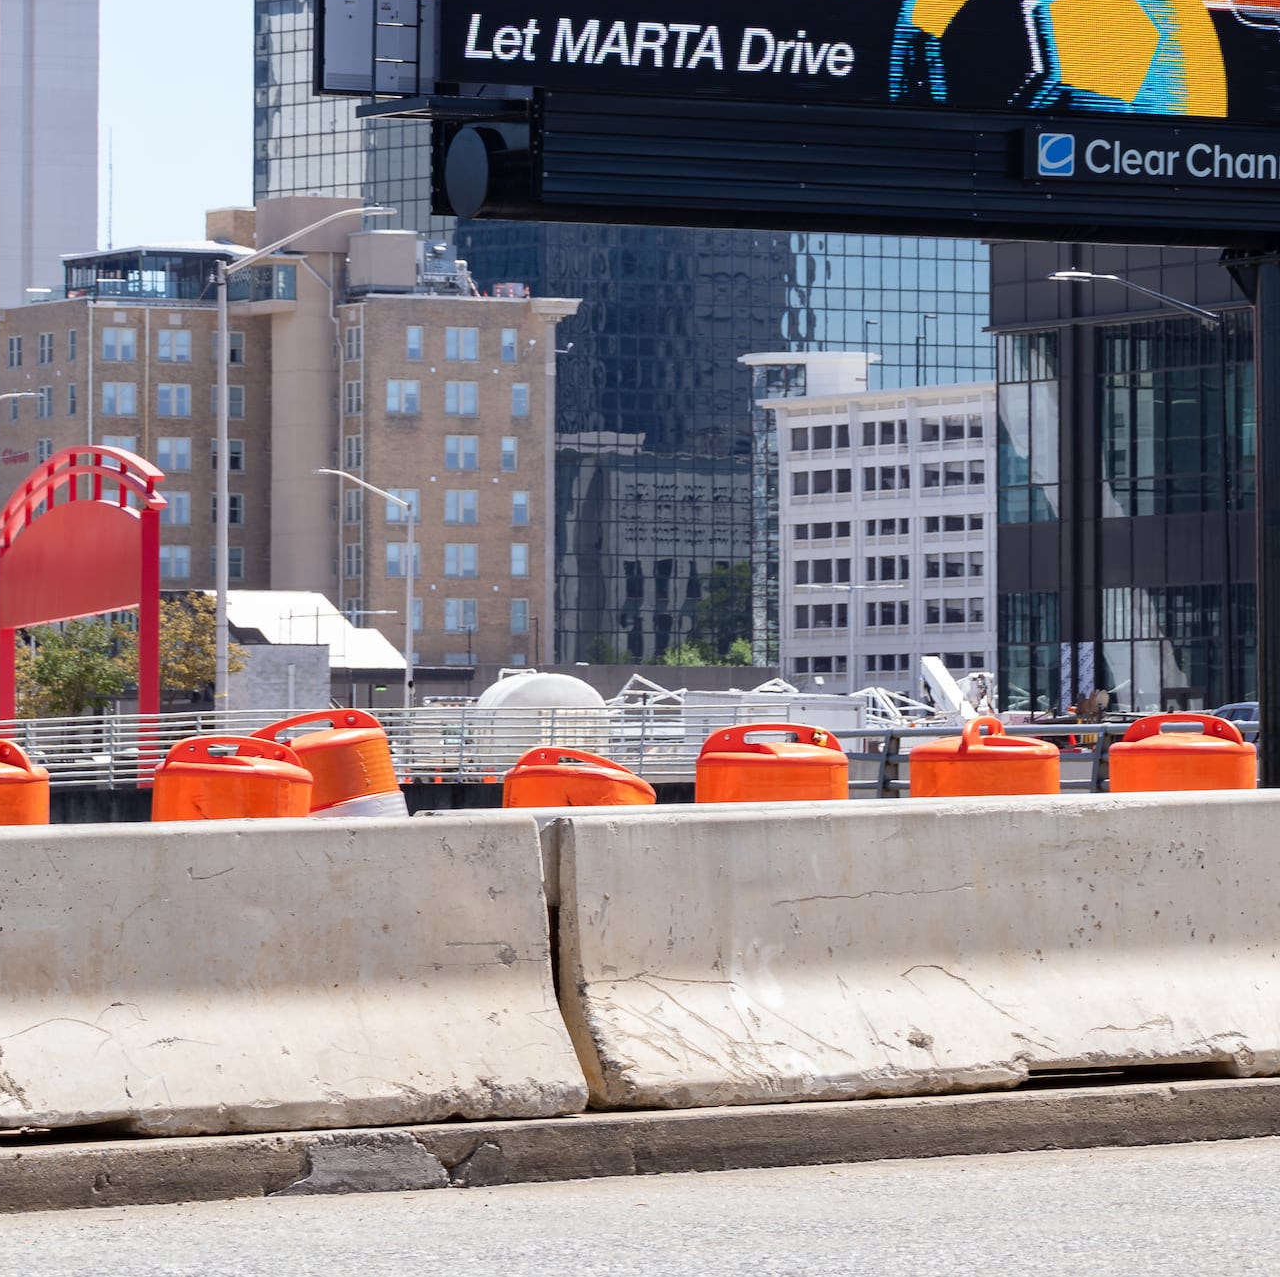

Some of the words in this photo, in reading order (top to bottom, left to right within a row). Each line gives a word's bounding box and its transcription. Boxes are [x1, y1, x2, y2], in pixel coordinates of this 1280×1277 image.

[464, 13, 540, 62] Let
[550, 17, 724, 71] MARTA
[737, 27, 855, 77] Drive
[1084, 139, 1180, 176] Clear
